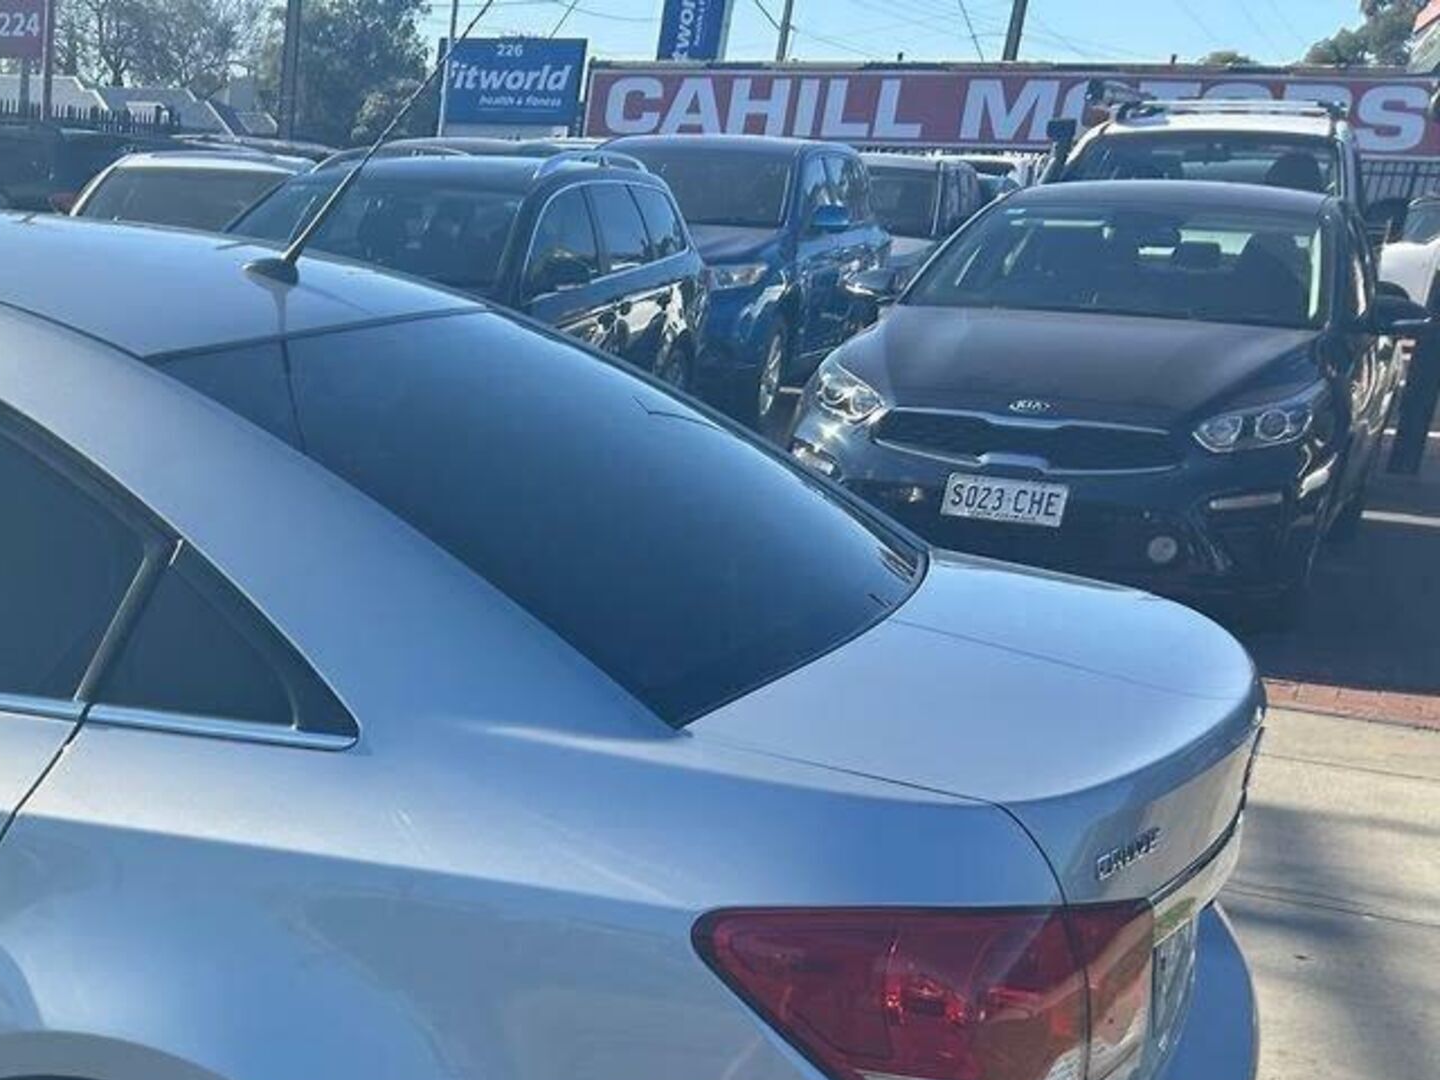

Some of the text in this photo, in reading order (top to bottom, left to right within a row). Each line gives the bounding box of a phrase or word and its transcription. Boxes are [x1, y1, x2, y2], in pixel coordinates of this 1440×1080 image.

[496, 43, 524, 57] 226
[604, 76, 922, 139] CAHILL
[1013, 489, 1061, 517] CHE
